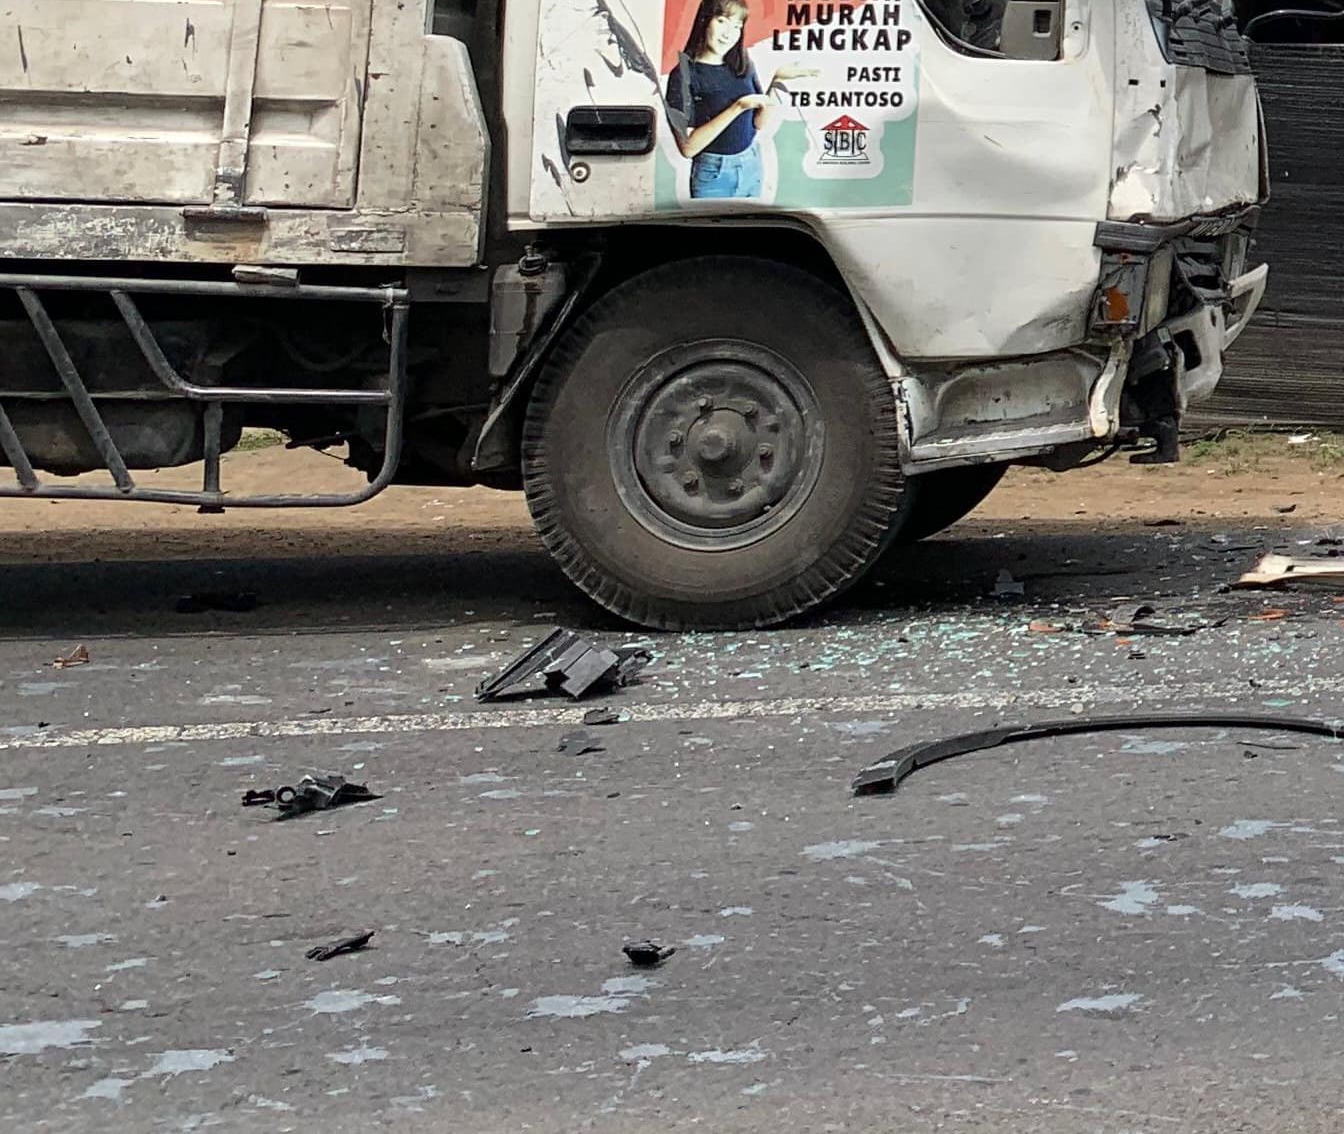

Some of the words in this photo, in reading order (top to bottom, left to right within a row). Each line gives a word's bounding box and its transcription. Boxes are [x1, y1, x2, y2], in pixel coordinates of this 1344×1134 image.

[786, 4, 901, 26] MURAH
[772, 28, 912, 51] LENGKAP
[847, 66, 902, 83] PASTI
[790, 91, 811, 107] TB
[815, 91, 904, 108] SANTOSO
